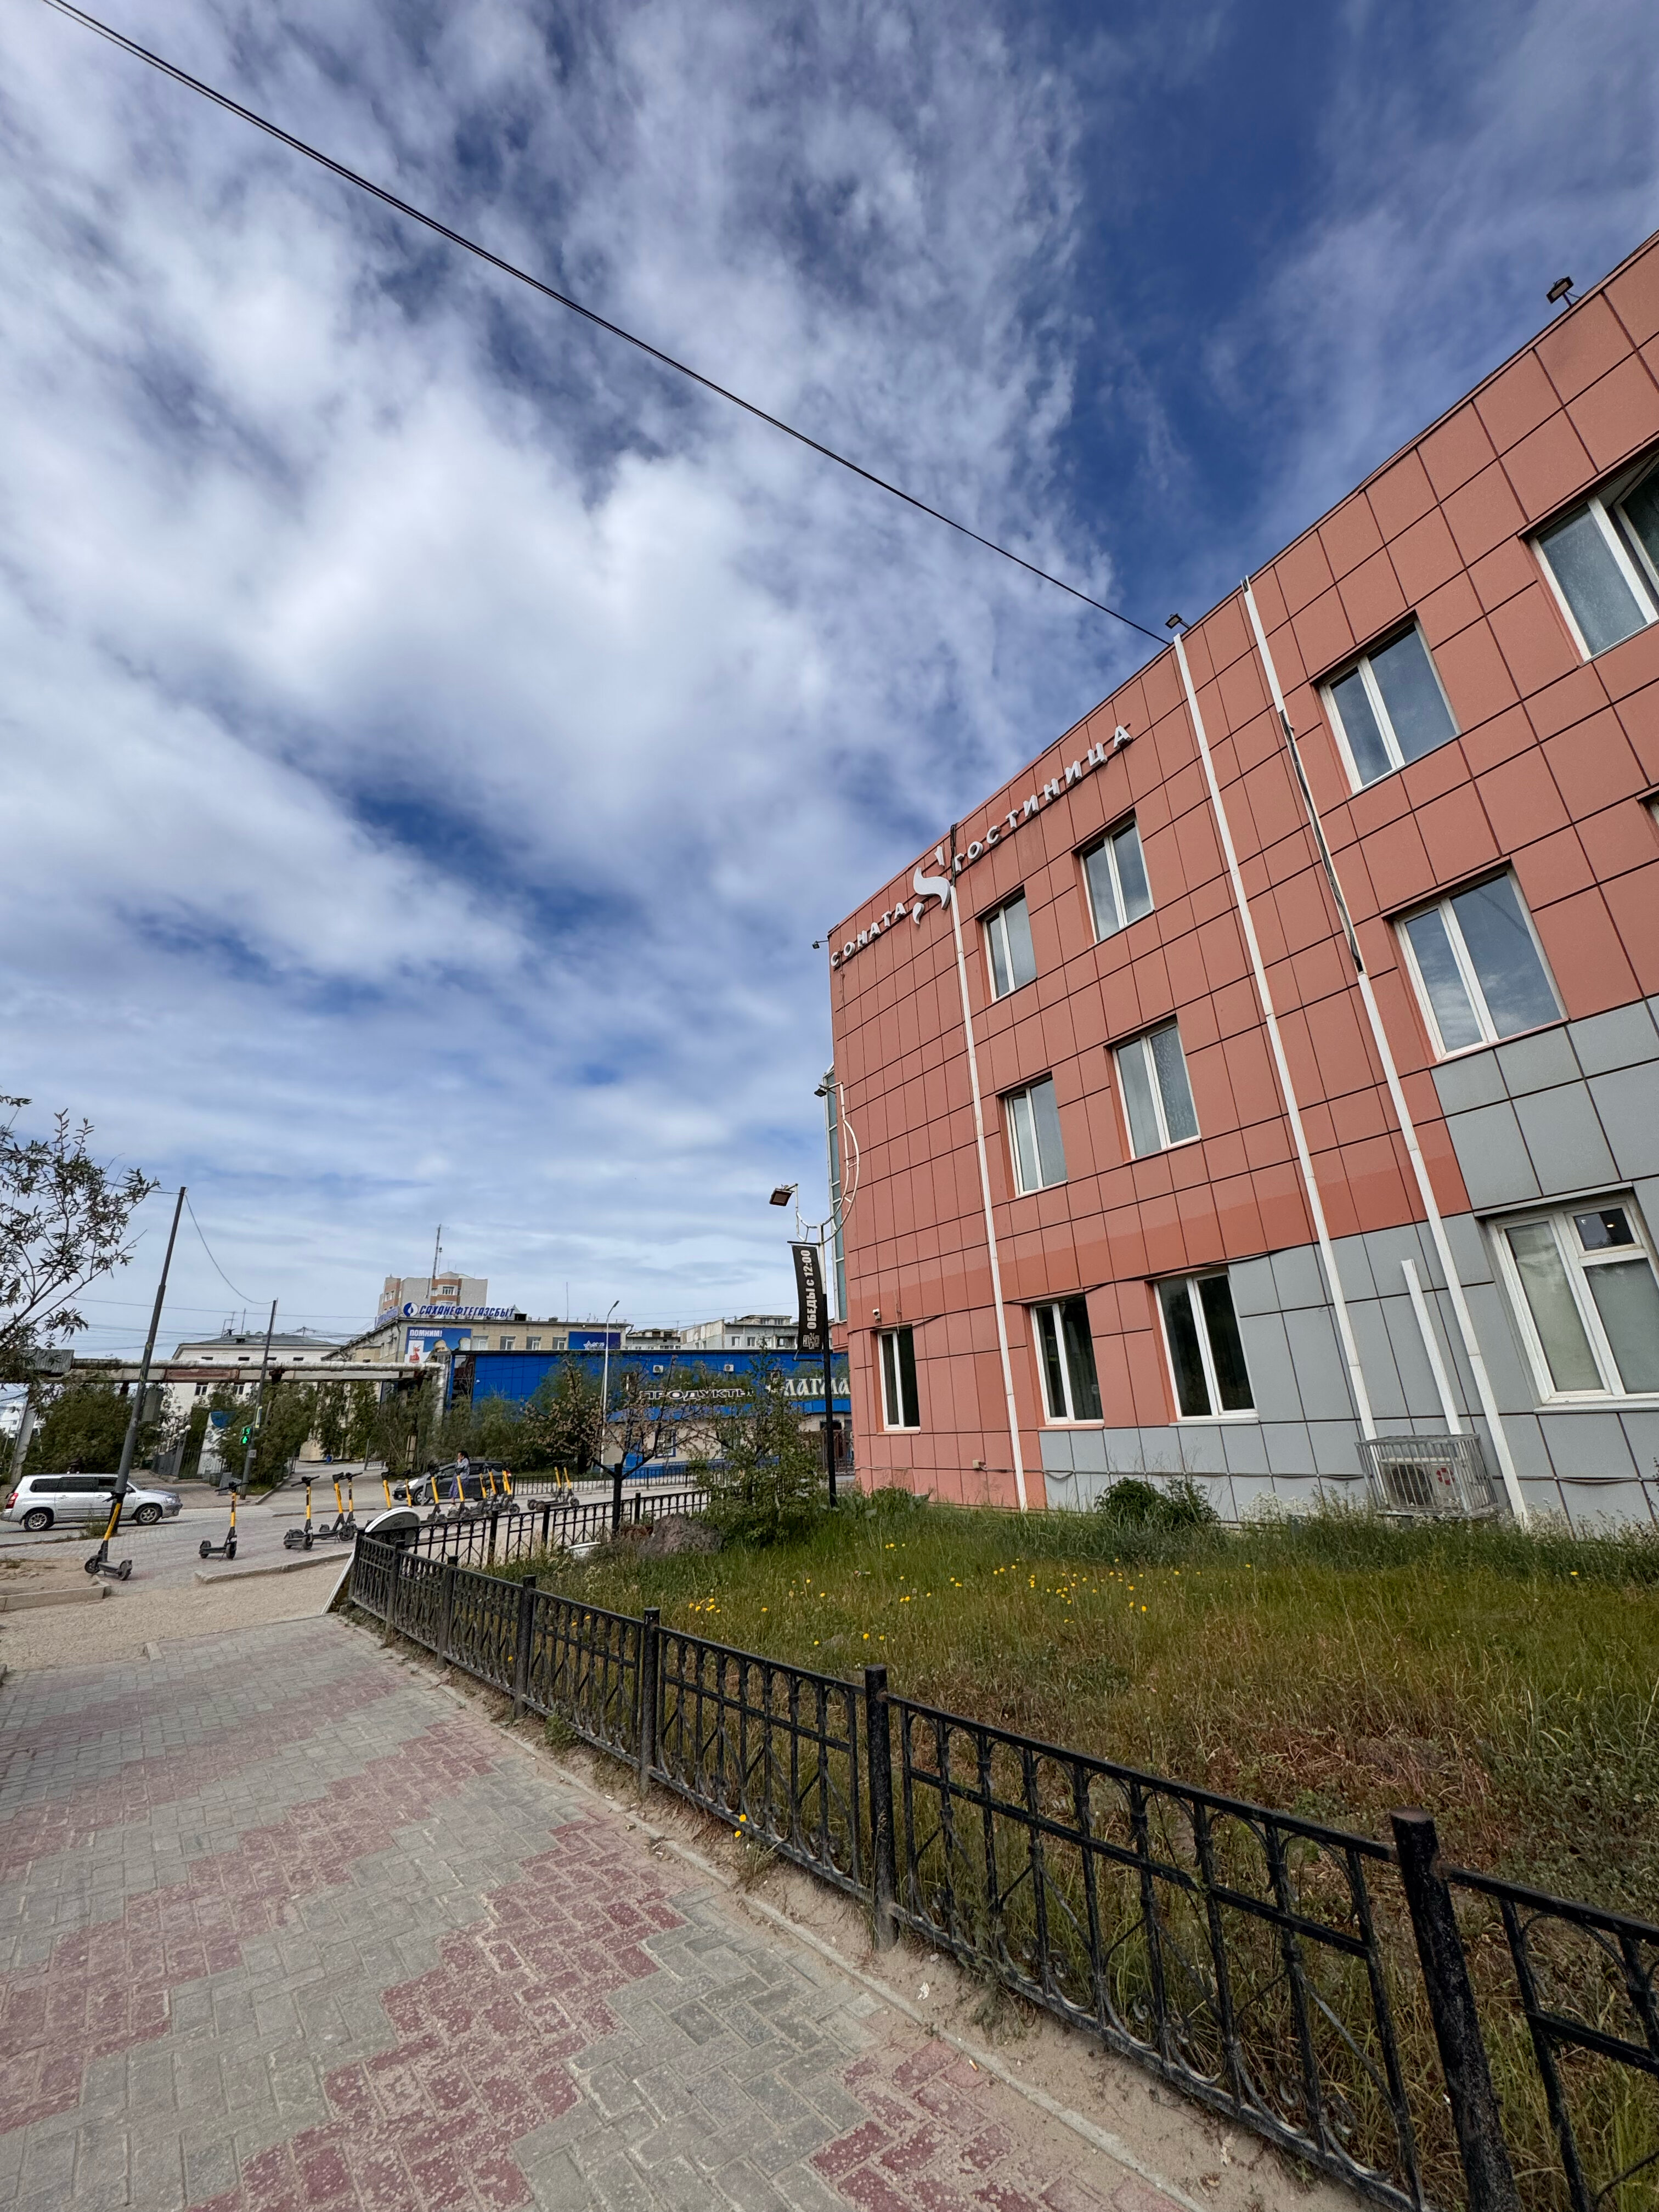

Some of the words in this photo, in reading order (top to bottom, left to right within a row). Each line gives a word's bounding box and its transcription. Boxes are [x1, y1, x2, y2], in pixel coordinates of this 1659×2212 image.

[955, 725, 1132, 872] ГОСТИНИЦА
[831, 902, 907, 967] СОНАТА
[800, 1250, 814, 1278] 12:00
[419, 1305, 515, 1317] САХАНЕФТЕГАЗСБЫТ
[805, 1288, 817, 1329] ОБЕДЫ
